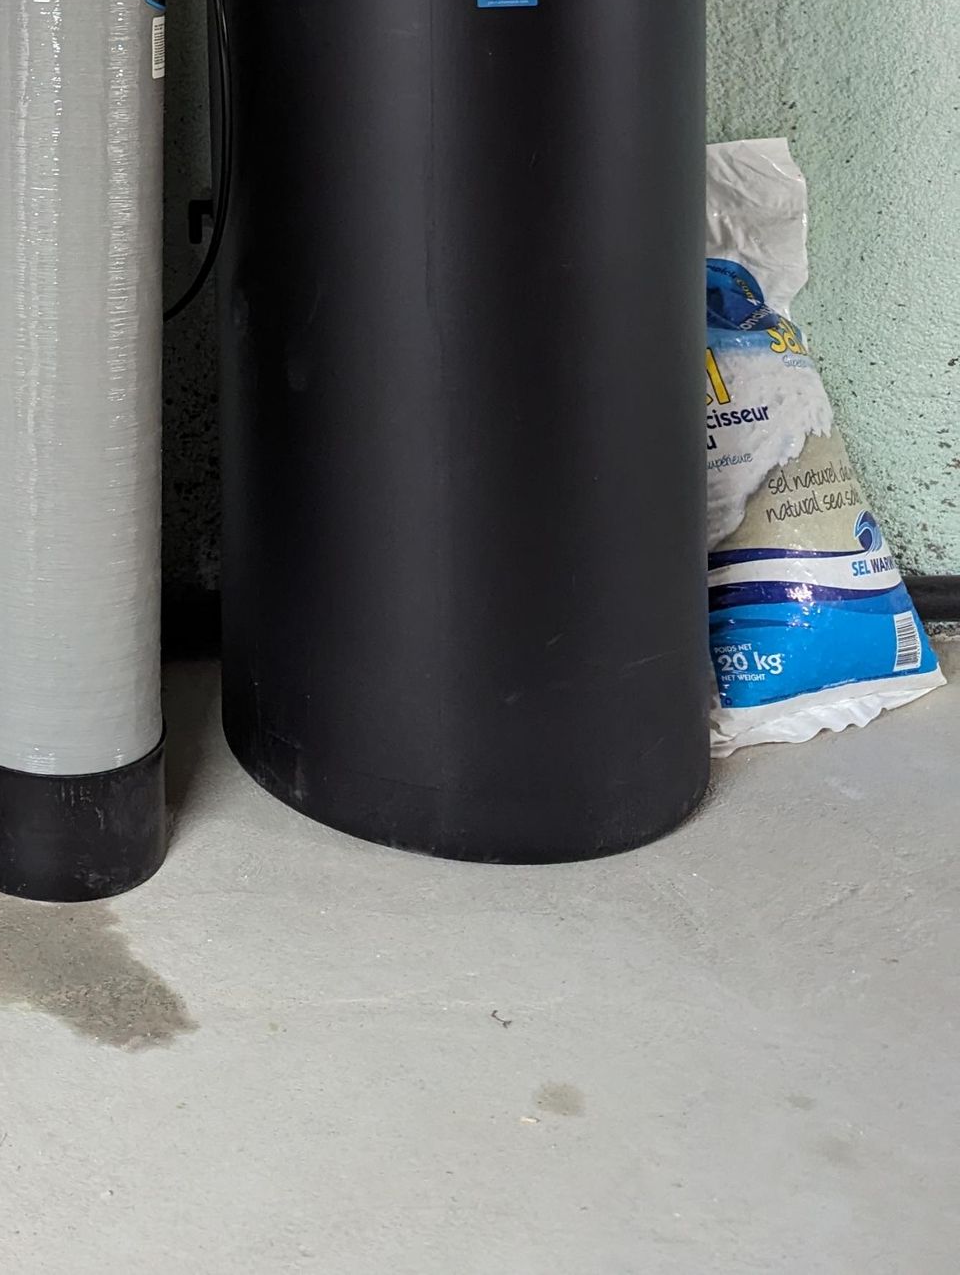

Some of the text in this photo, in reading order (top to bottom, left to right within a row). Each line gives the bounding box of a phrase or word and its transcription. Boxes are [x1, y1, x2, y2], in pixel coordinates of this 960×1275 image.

[768, 469, 793, 495] sel
[793, 461, 838, 492] naturel
[766, 490, 823, 523] natural
[851, 560, 871, 576] SEL
[737, 643, 752, 652] NET
[718, 651, 783, 675] 20 kg
[721, 673, 766, 682] NET WEIGHT
